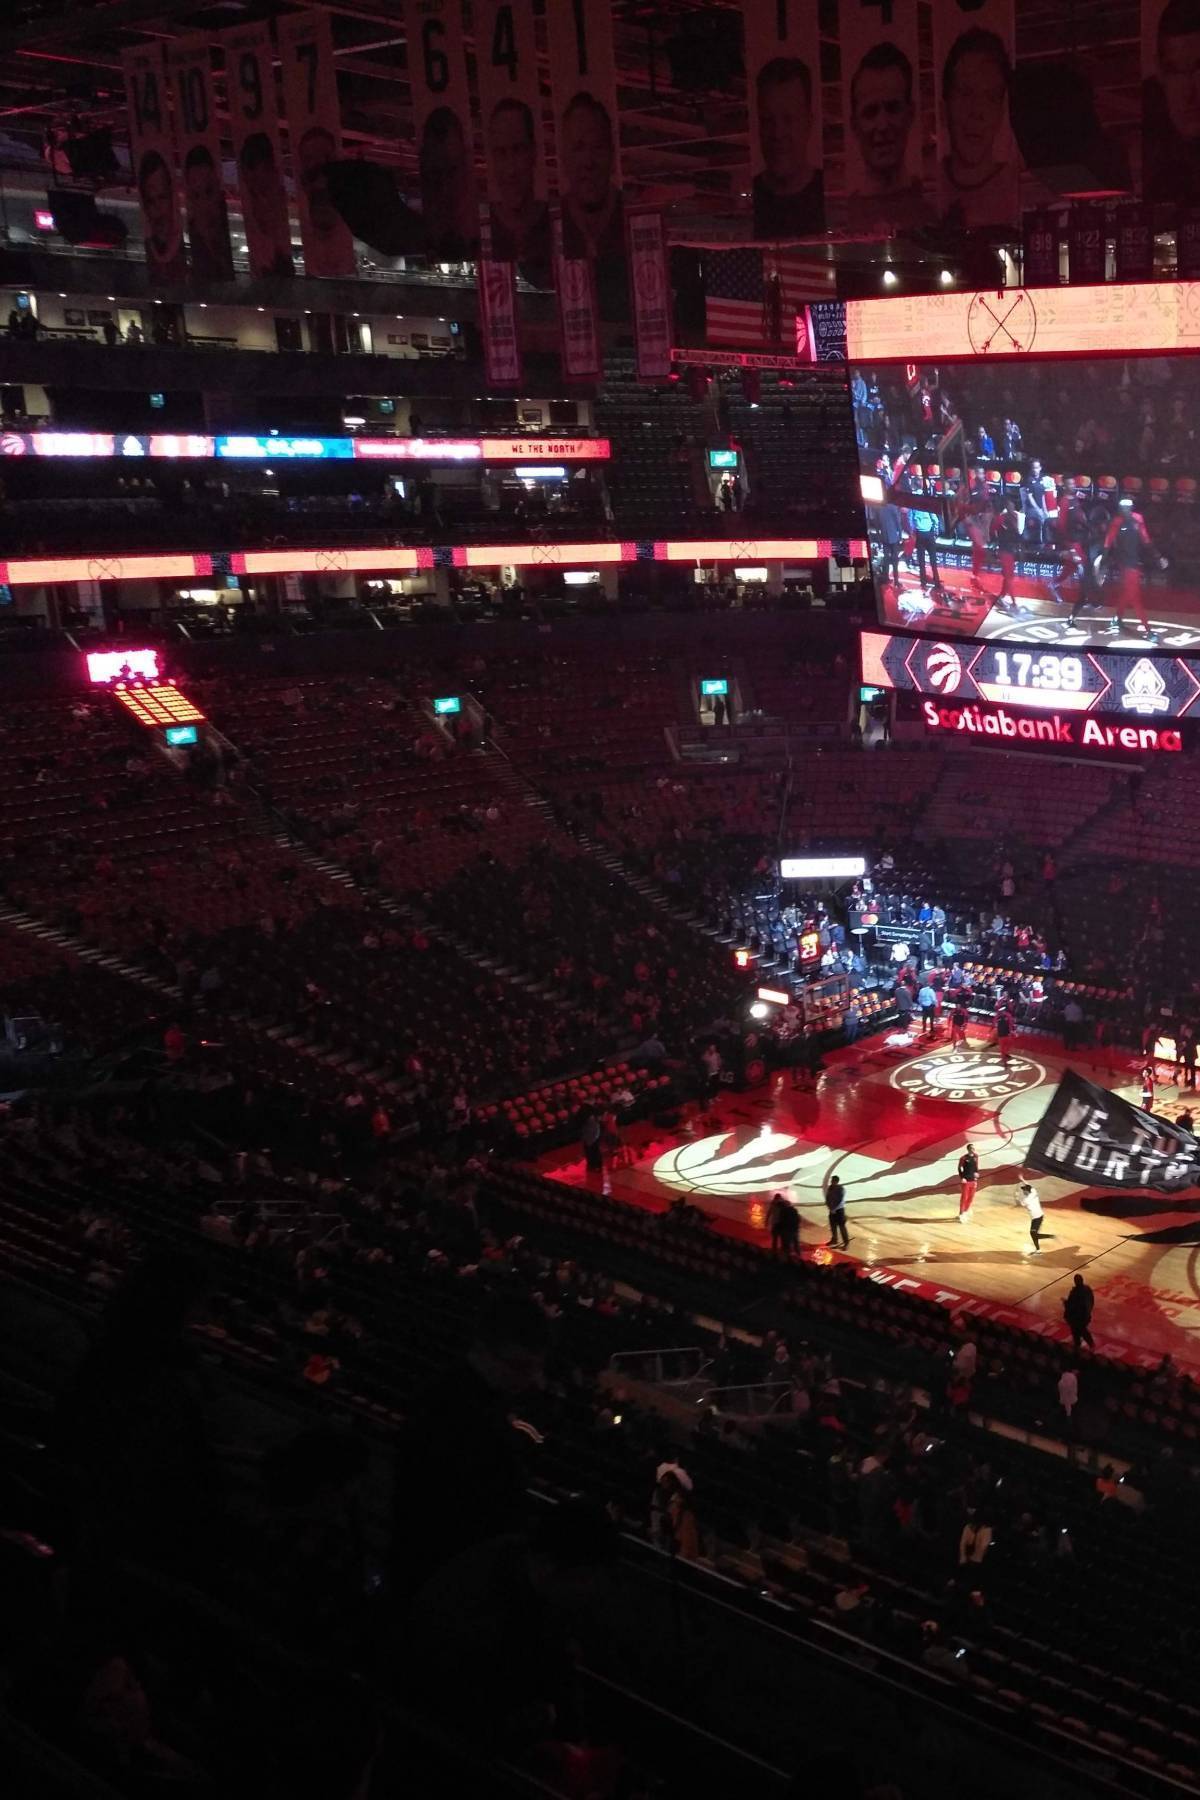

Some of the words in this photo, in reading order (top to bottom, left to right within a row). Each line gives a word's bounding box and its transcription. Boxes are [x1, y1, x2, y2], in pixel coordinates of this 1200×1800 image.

[423, 19, 449, 92] 6
[492, 6, 518, 81] 4
[130, 72, 161, 135] 14
[179, 67, 208, 133] 10
[240, 53, 262, 119] 9
[296, 44, 318, 114] 7
[528, 444, 543, 453] THE
[993, 651, 1083, 690] 17:39
[923, 701, 1074, 742] Scotiabank
[1083, 719, 1182, 750] Arena
[901, 1079, 1027, 1099] TORONTO
[1059, 1097, 1109, 1142] WE
